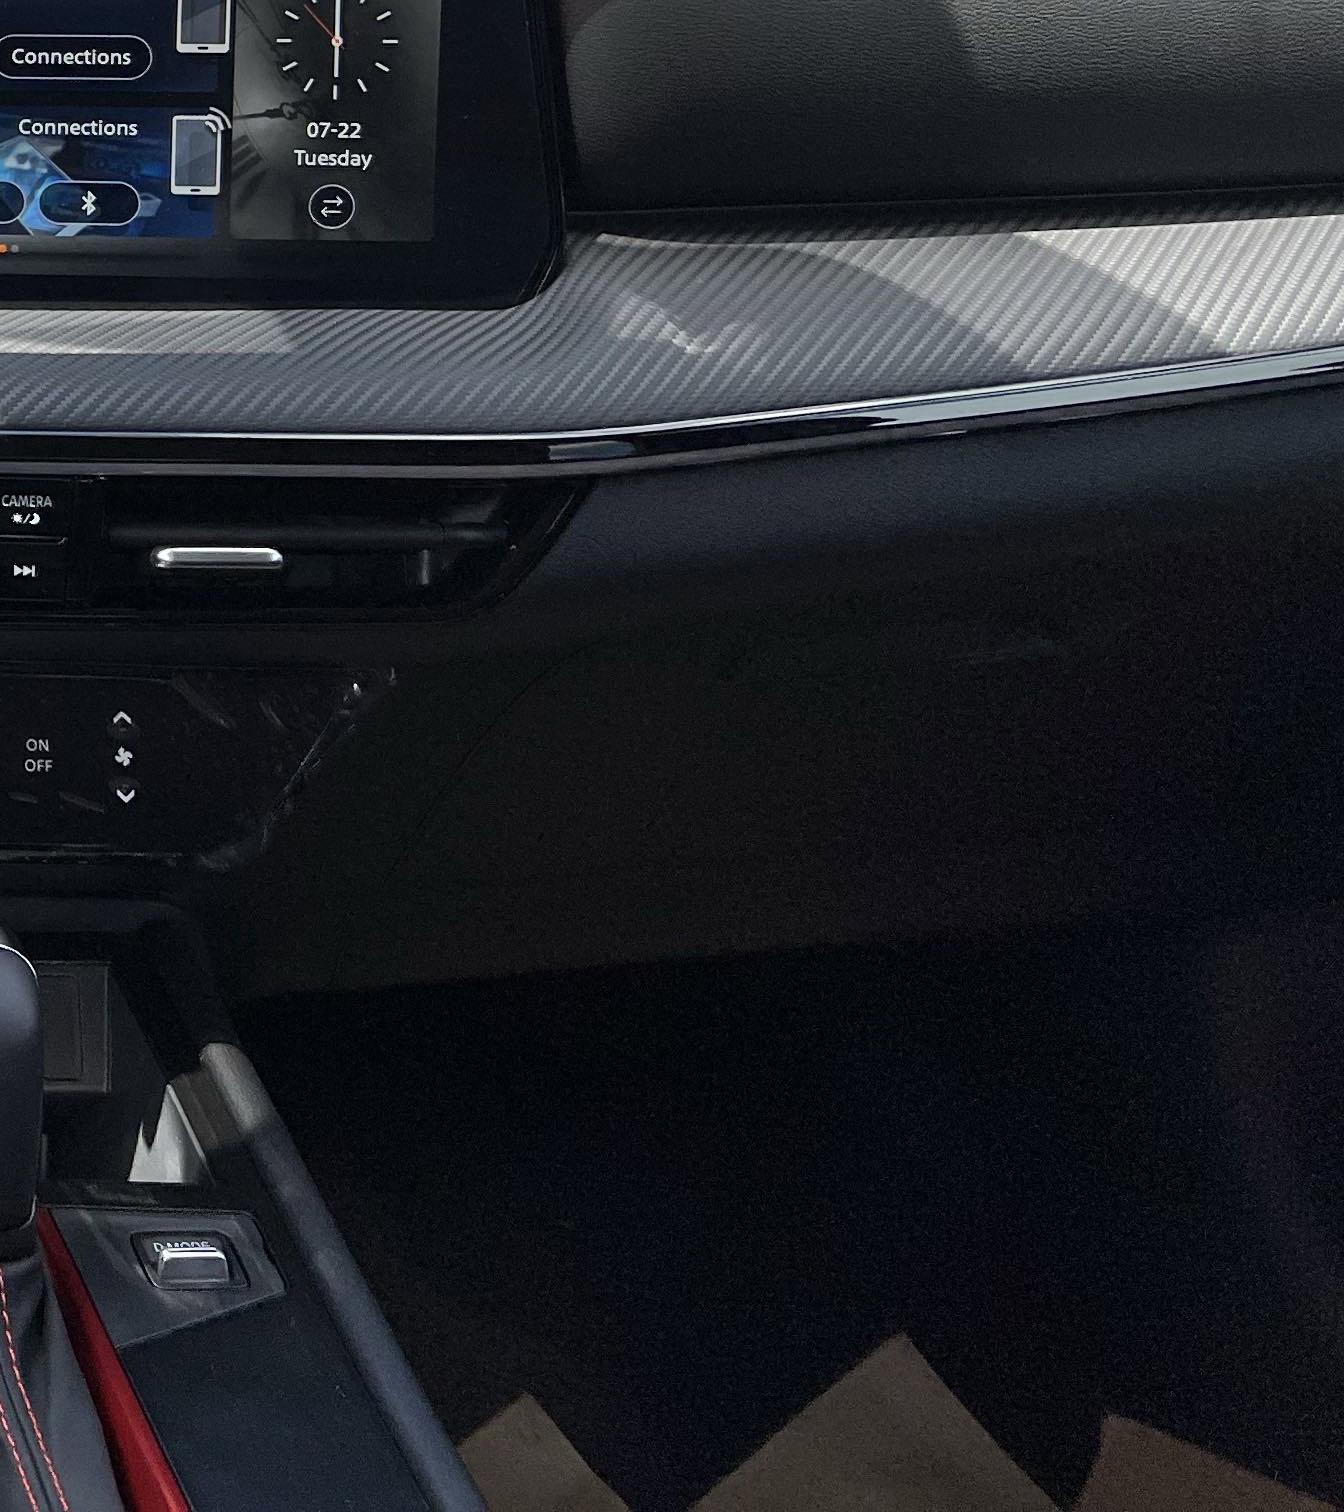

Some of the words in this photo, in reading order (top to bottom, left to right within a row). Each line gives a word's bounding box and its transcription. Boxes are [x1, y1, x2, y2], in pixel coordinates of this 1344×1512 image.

[11, 48, 131, 66] Connections
[18, 119, 138, 137] Connections
[306, 122, 362, 140] 07-22
[293, 149, 373, 171] Tuesday
[1, 494, 53, 508] CAMERA
[25, 738, 50, 753] ON
[24, 758, 54, 773] OFF
